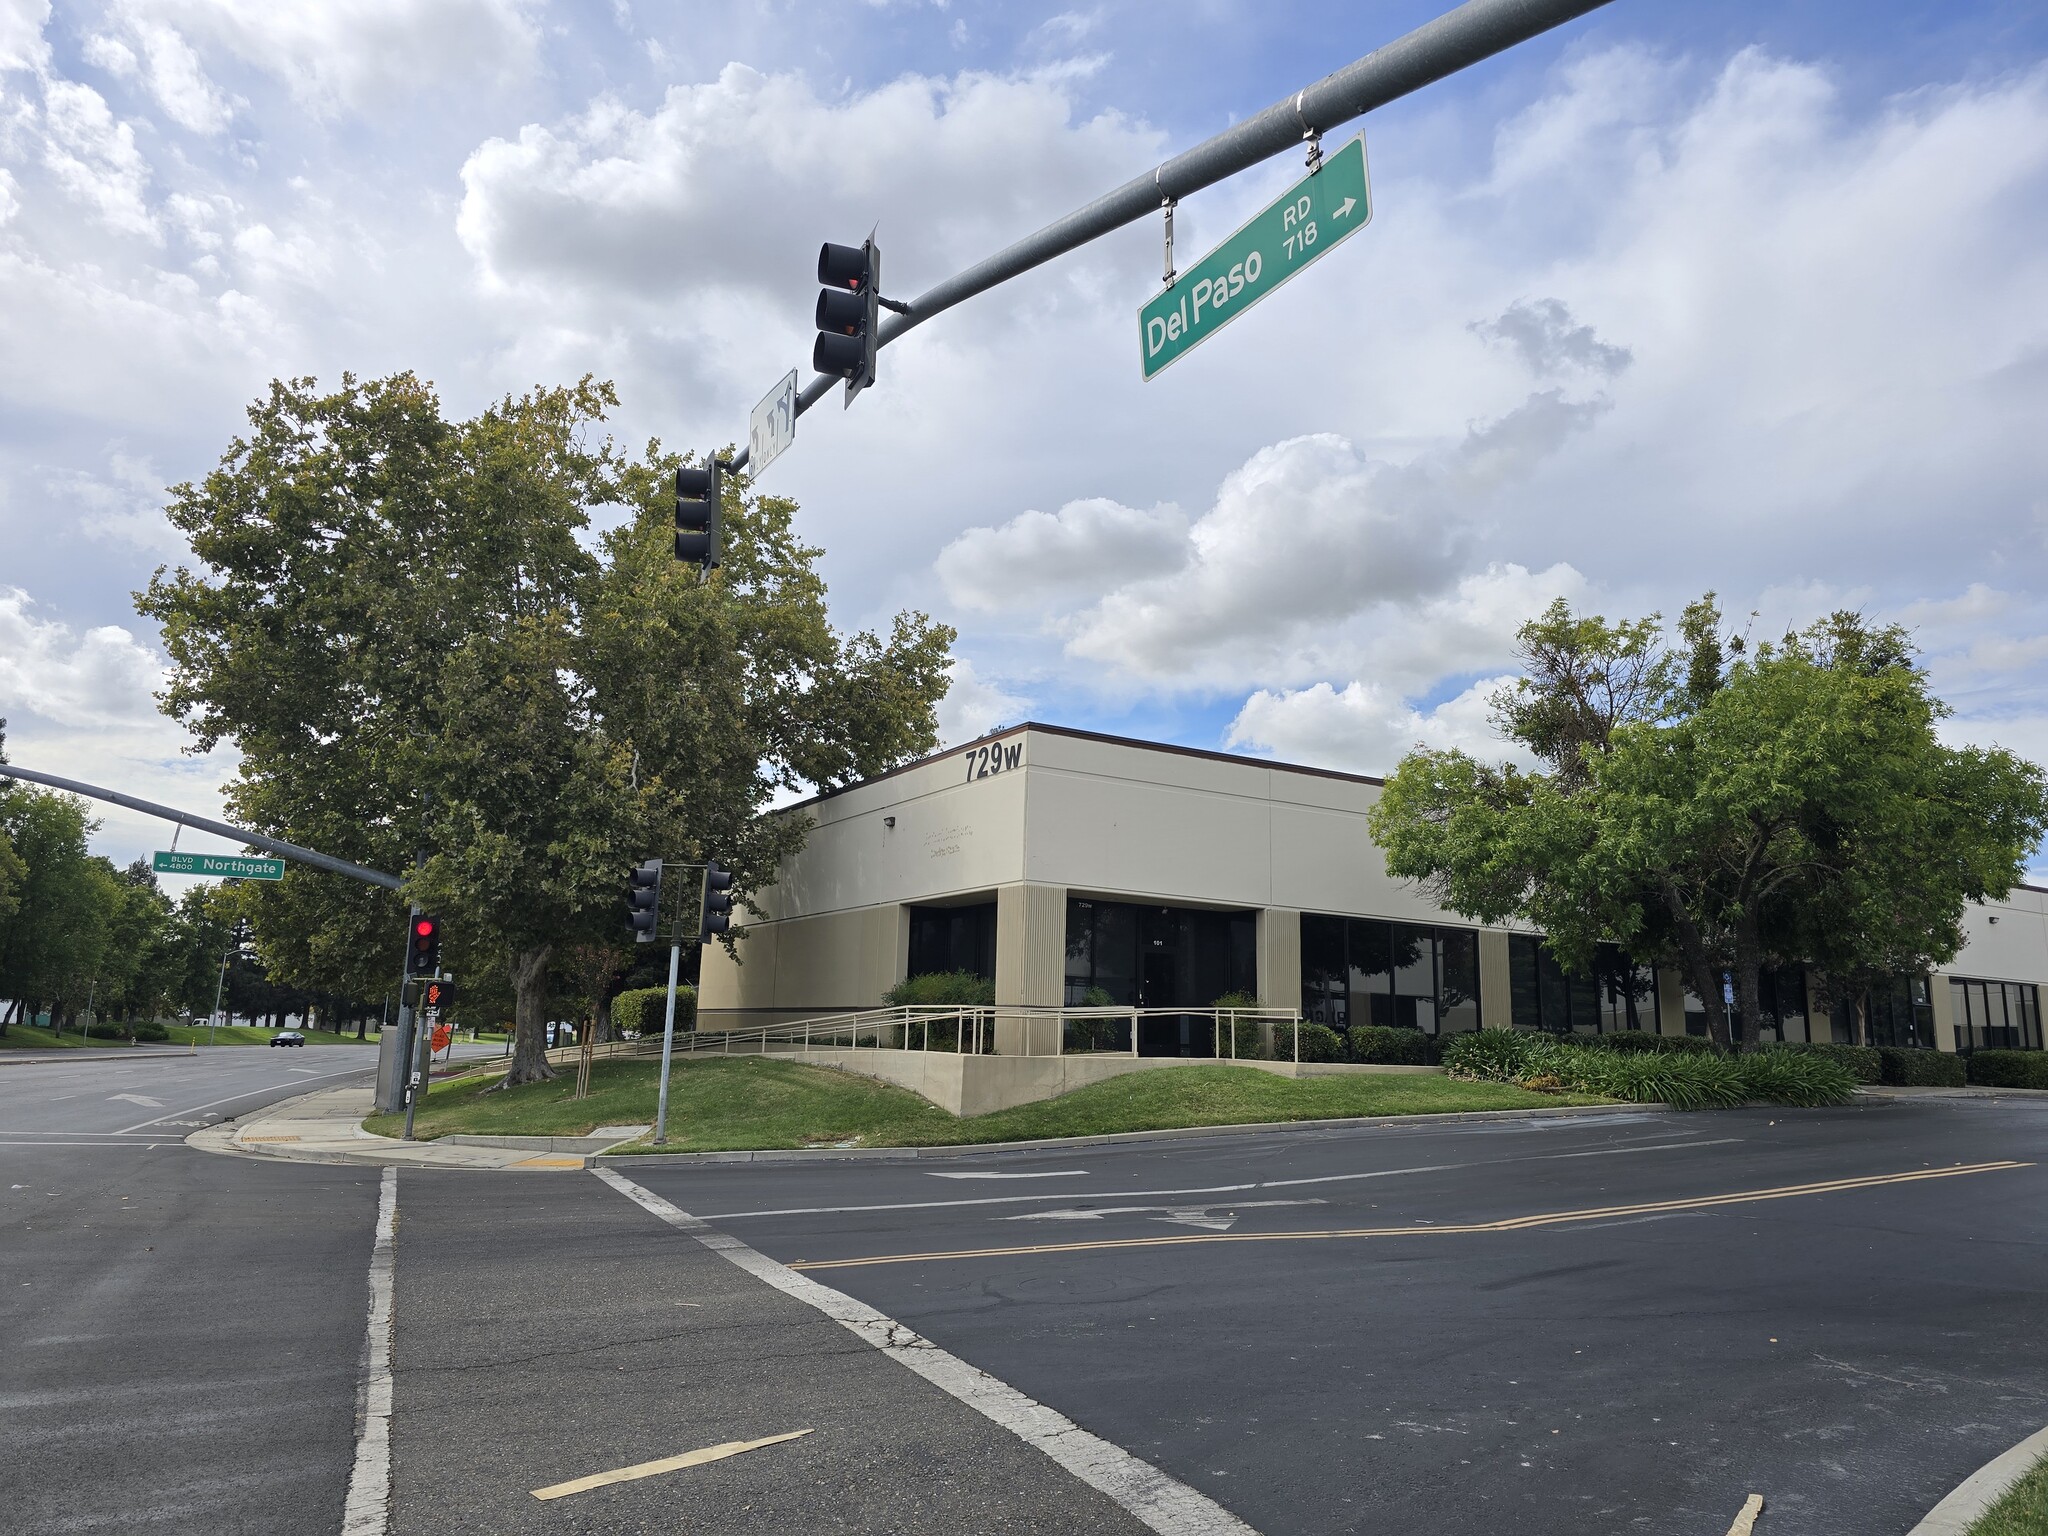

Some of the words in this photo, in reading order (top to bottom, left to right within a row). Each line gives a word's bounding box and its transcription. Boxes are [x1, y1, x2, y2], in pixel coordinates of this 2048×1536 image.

[1283, 195, 1311, 232] RD
[1282, 221, 1318, 260] 718
[1147, 294, 1188, 358] Del
[1192, 251, 1262, 325] Paso
[171, 856, 193, 864] BLVD
[203, 858, 276, 875] Northgate
